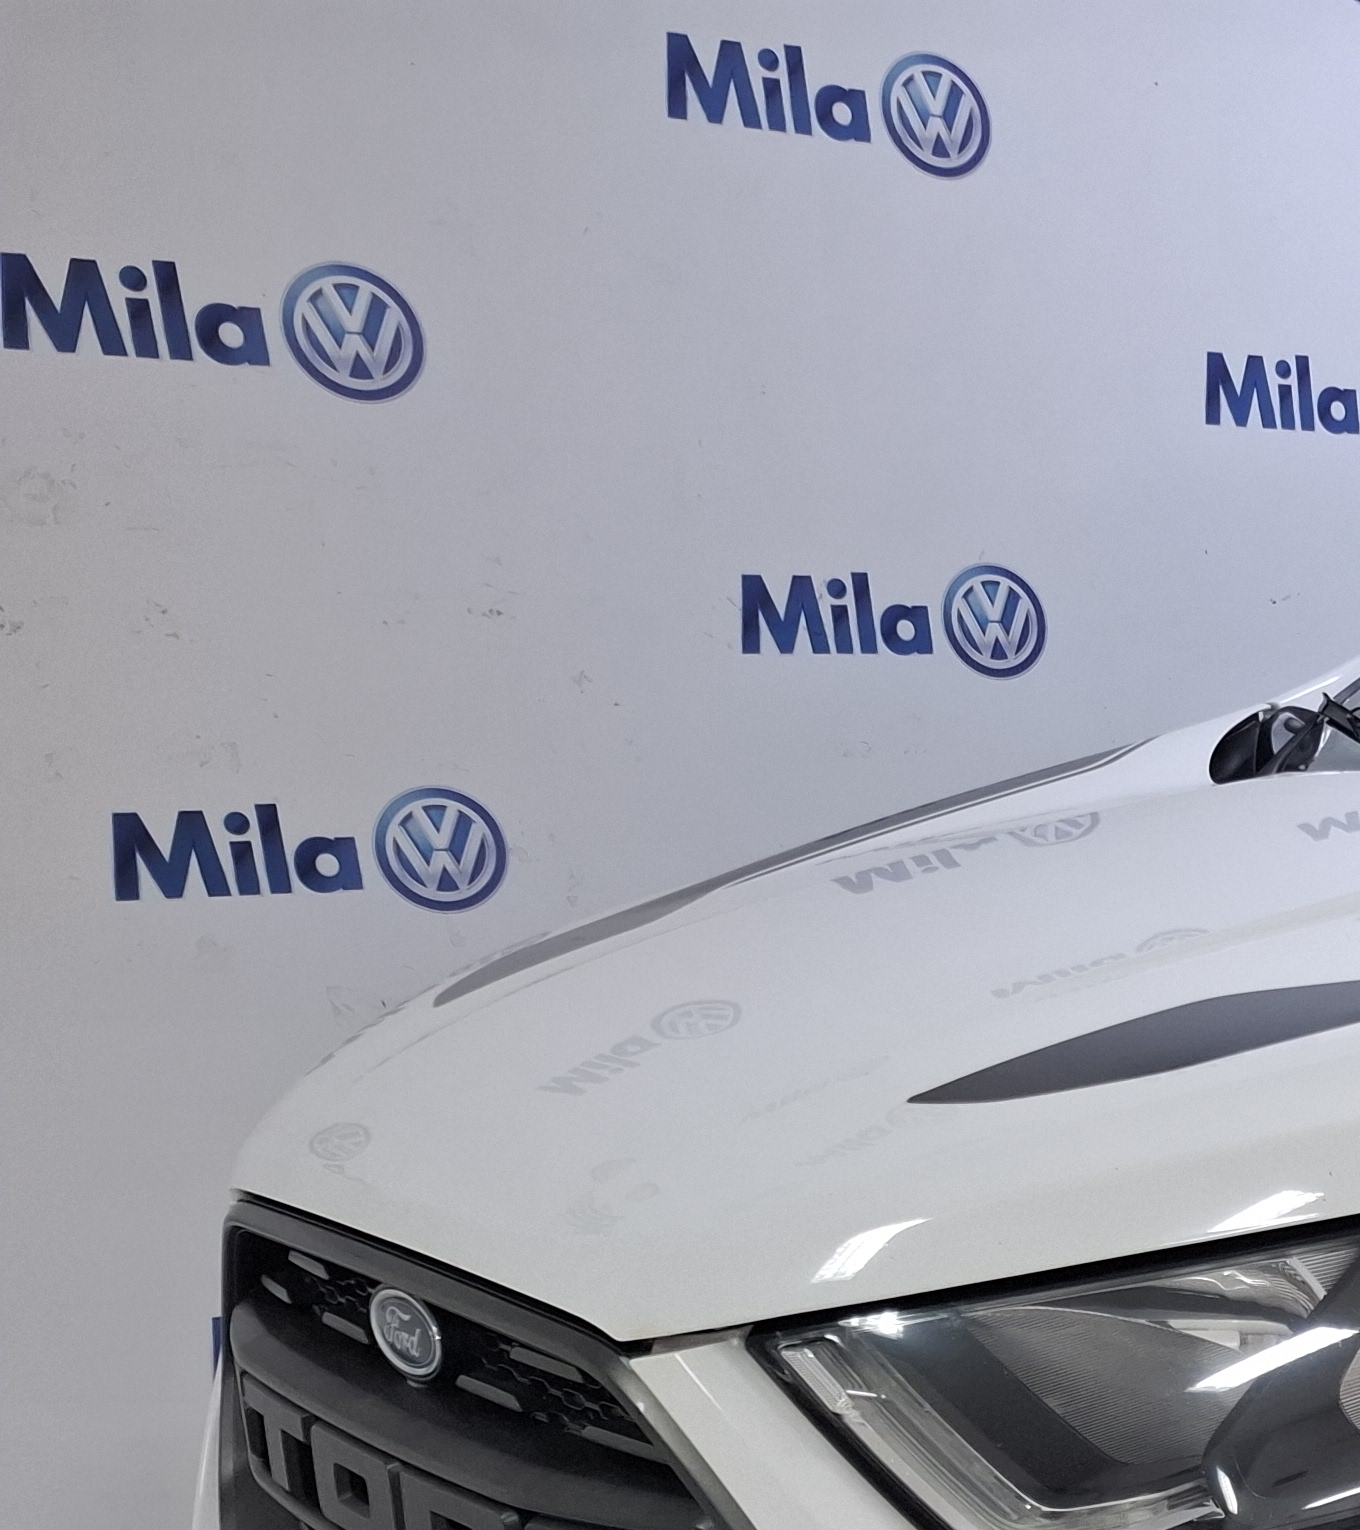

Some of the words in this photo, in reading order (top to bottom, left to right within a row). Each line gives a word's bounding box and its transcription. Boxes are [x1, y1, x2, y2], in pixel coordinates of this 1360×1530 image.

[666, 31, 872, 144] Mila
[0, 251, 271, 367] Mila
[1205, 351, 1360, 435] Mila
[741, 571, 934, 656] Mila
[111, 803, 364, 902] Mila
[384, 1305, 422, 1358] Ford
